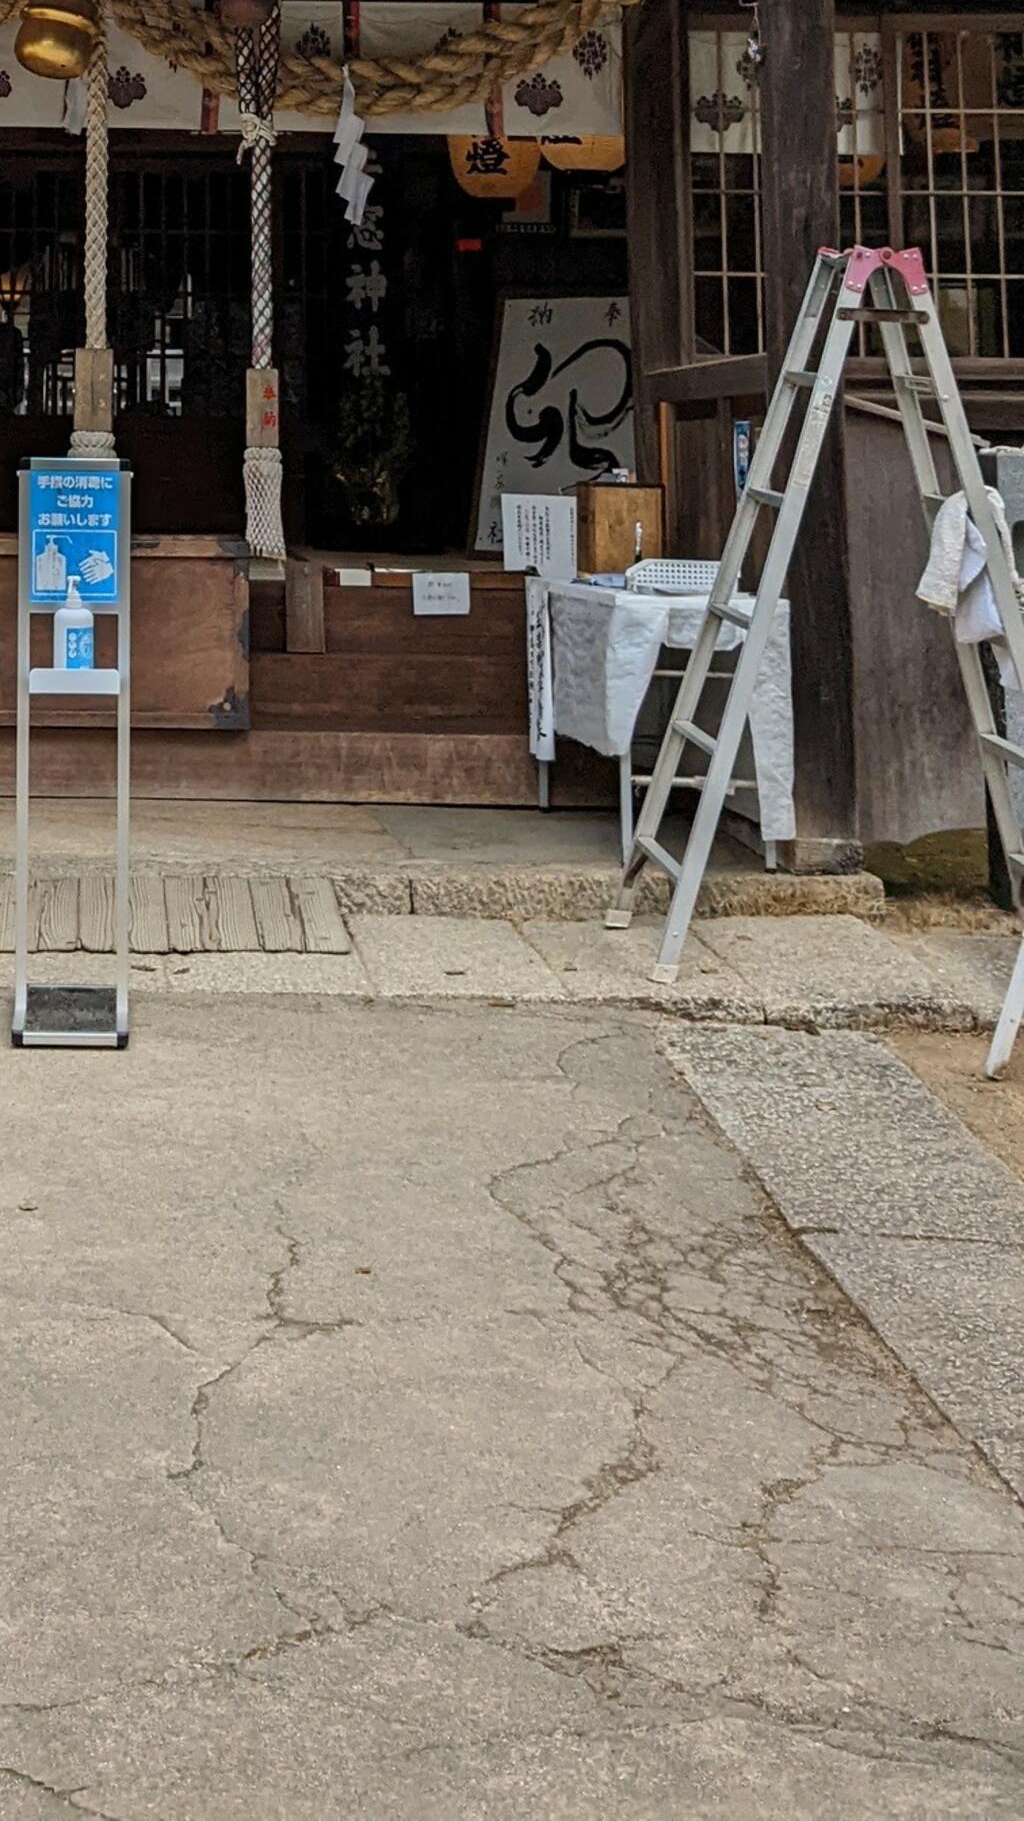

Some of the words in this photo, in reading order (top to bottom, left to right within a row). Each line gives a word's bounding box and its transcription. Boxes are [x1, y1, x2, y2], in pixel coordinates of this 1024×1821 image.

[37, 474, 113, 490] 手指の消毒に
[56, 494, 94, 509] ご協力
[37, 512, 113, 527] お願いします
